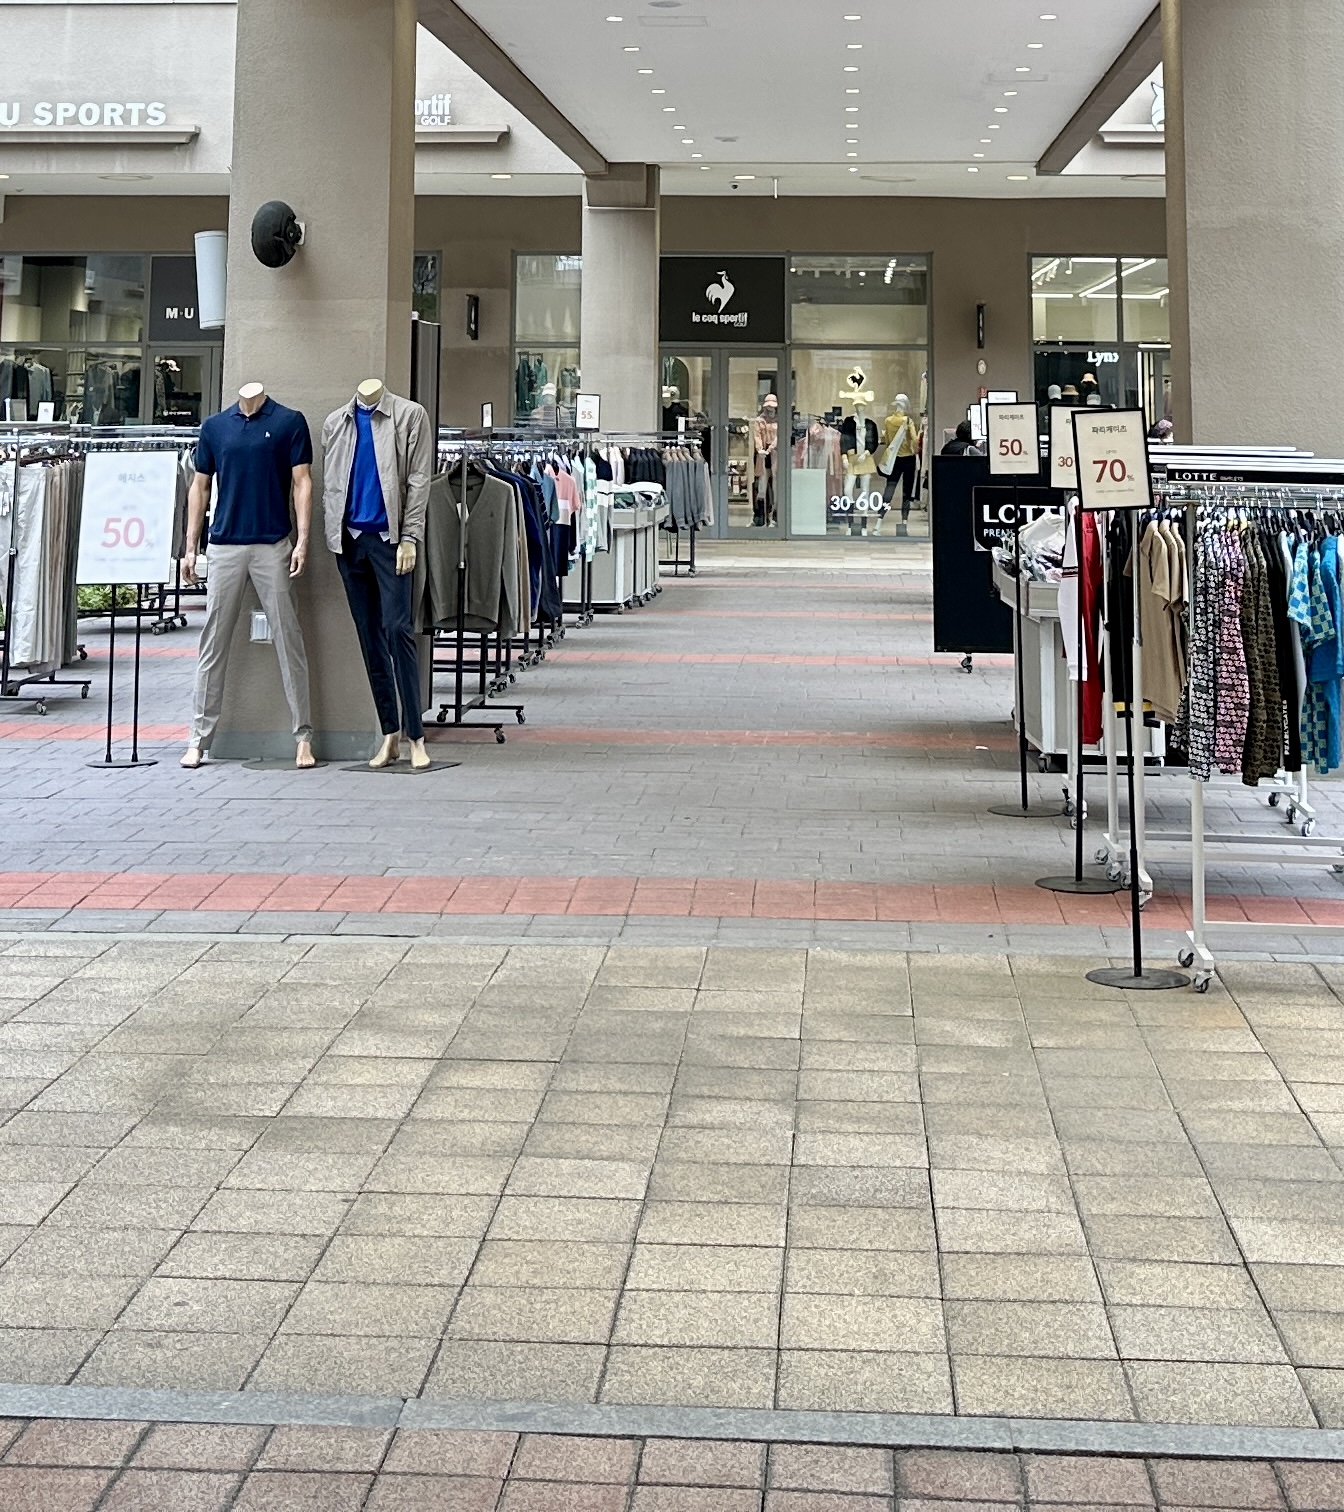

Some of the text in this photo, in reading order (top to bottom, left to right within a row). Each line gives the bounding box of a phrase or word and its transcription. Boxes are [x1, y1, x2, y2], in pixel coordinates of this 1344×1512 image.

[32, 101, 167, 126] SPORTS
[421, 116, 451, 125] GOLF
[1175, 472, 1217, 481] LOTTE
